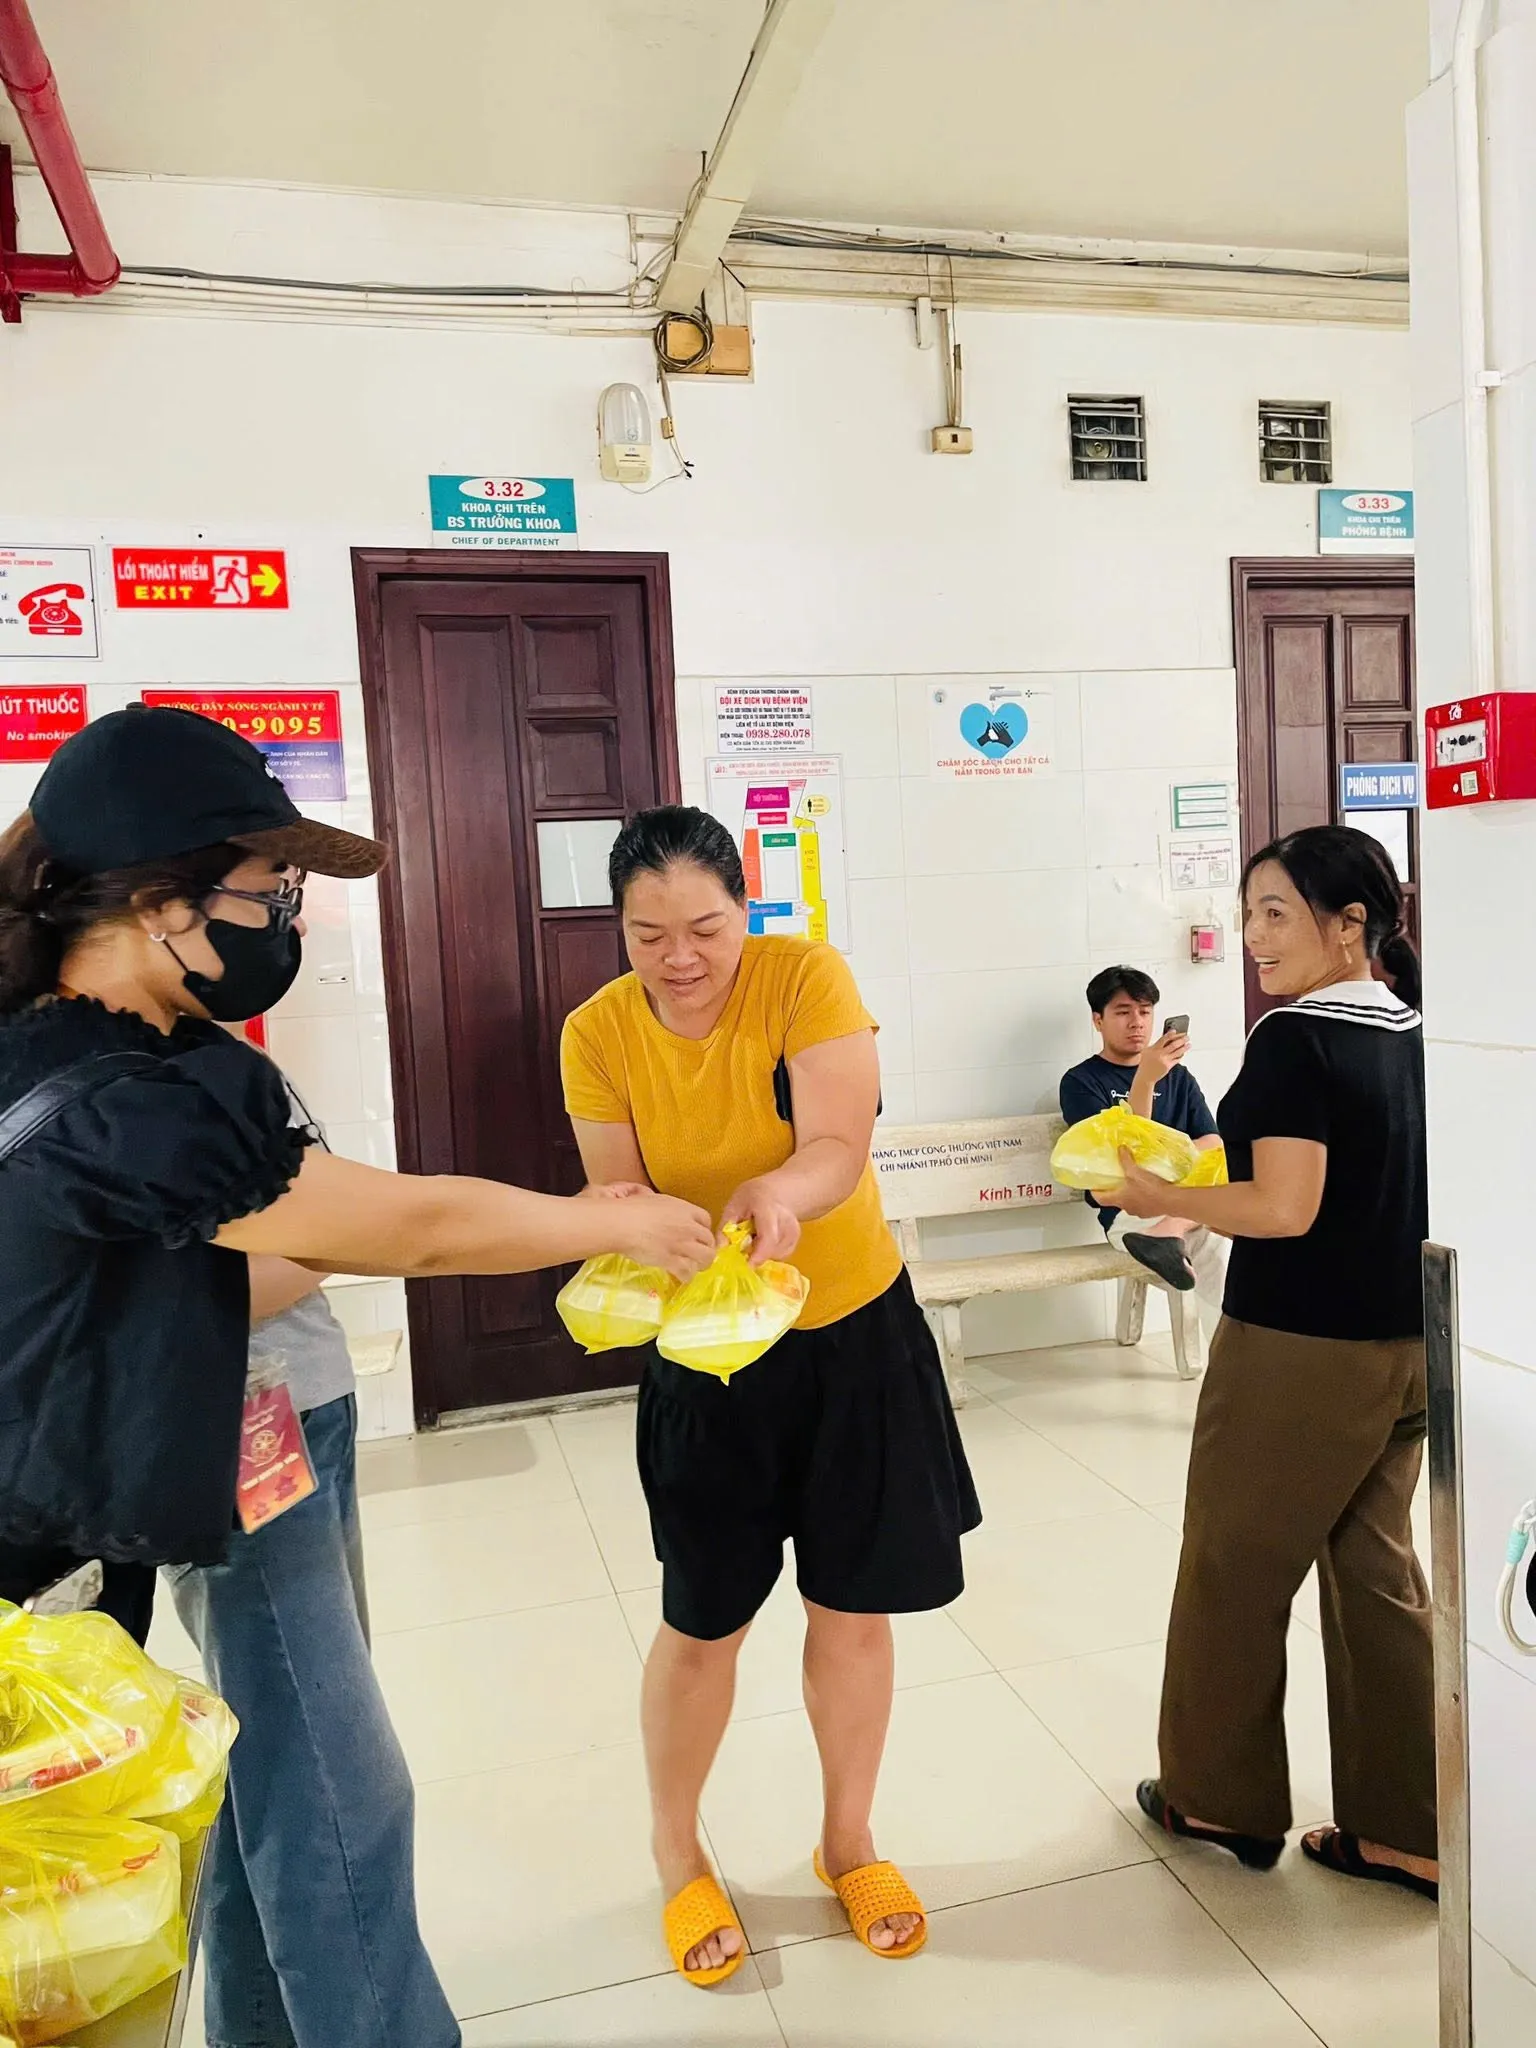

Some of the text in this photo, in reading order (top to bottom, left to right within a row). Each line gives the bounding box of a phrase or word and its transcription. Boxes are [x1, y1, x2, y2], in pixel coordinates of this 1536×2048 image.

[484, 481, 524, 497] 3.32
[462, 502, 545, 514] KHOA CHI TRÊN
[1358, 497, 1390, 509] 3.33
[448, 514, 561, 530] BS TRƯỞNG KHOA
[1342, 525, 1407, 538] PHÒNG BỆNH
[452, 537, 559, 546] CHIEF OF DEPARTMENT
[117, 556, 136, 580] LỐI
[138, 559, 177, 580] THOÁT
[134, 585, 193, 600] EXIT
[0, 691, 80, 715] ÚT THUỐC
[202, 702, 223, 711] DÂY
[224, 701, 258, 711] NÓNG
[259, 701, 299, 711] NGÀNH
[300, 703, 309, 711] Y
[312, 701, 325, 711] TẾ
[734, 696, 742, 704] XE
[744, 696, 760, 705] DỊCH
[762, 696, 771, 705] VỤ
[773, 695, 790, 705] BỆNH
[793, 695, 808, 705] VIỆN
[7, 730, 76, 741] No smokin
[745, 728, 811, 738] 0938.280.078
[963, 758, 978, 766] SÓC
[1346, 772, 1415, 800] PHÒNG DỊCH VỤ
[898, 1147, 920, 1157] TMCP
[1003, 1138, 1022, 1148] NAM
[954, 1154, 969, 1166] CHÍ
[970, 1154, 993, 1164] MINH
[1017, 1183, 1052, 1198] Tặng
